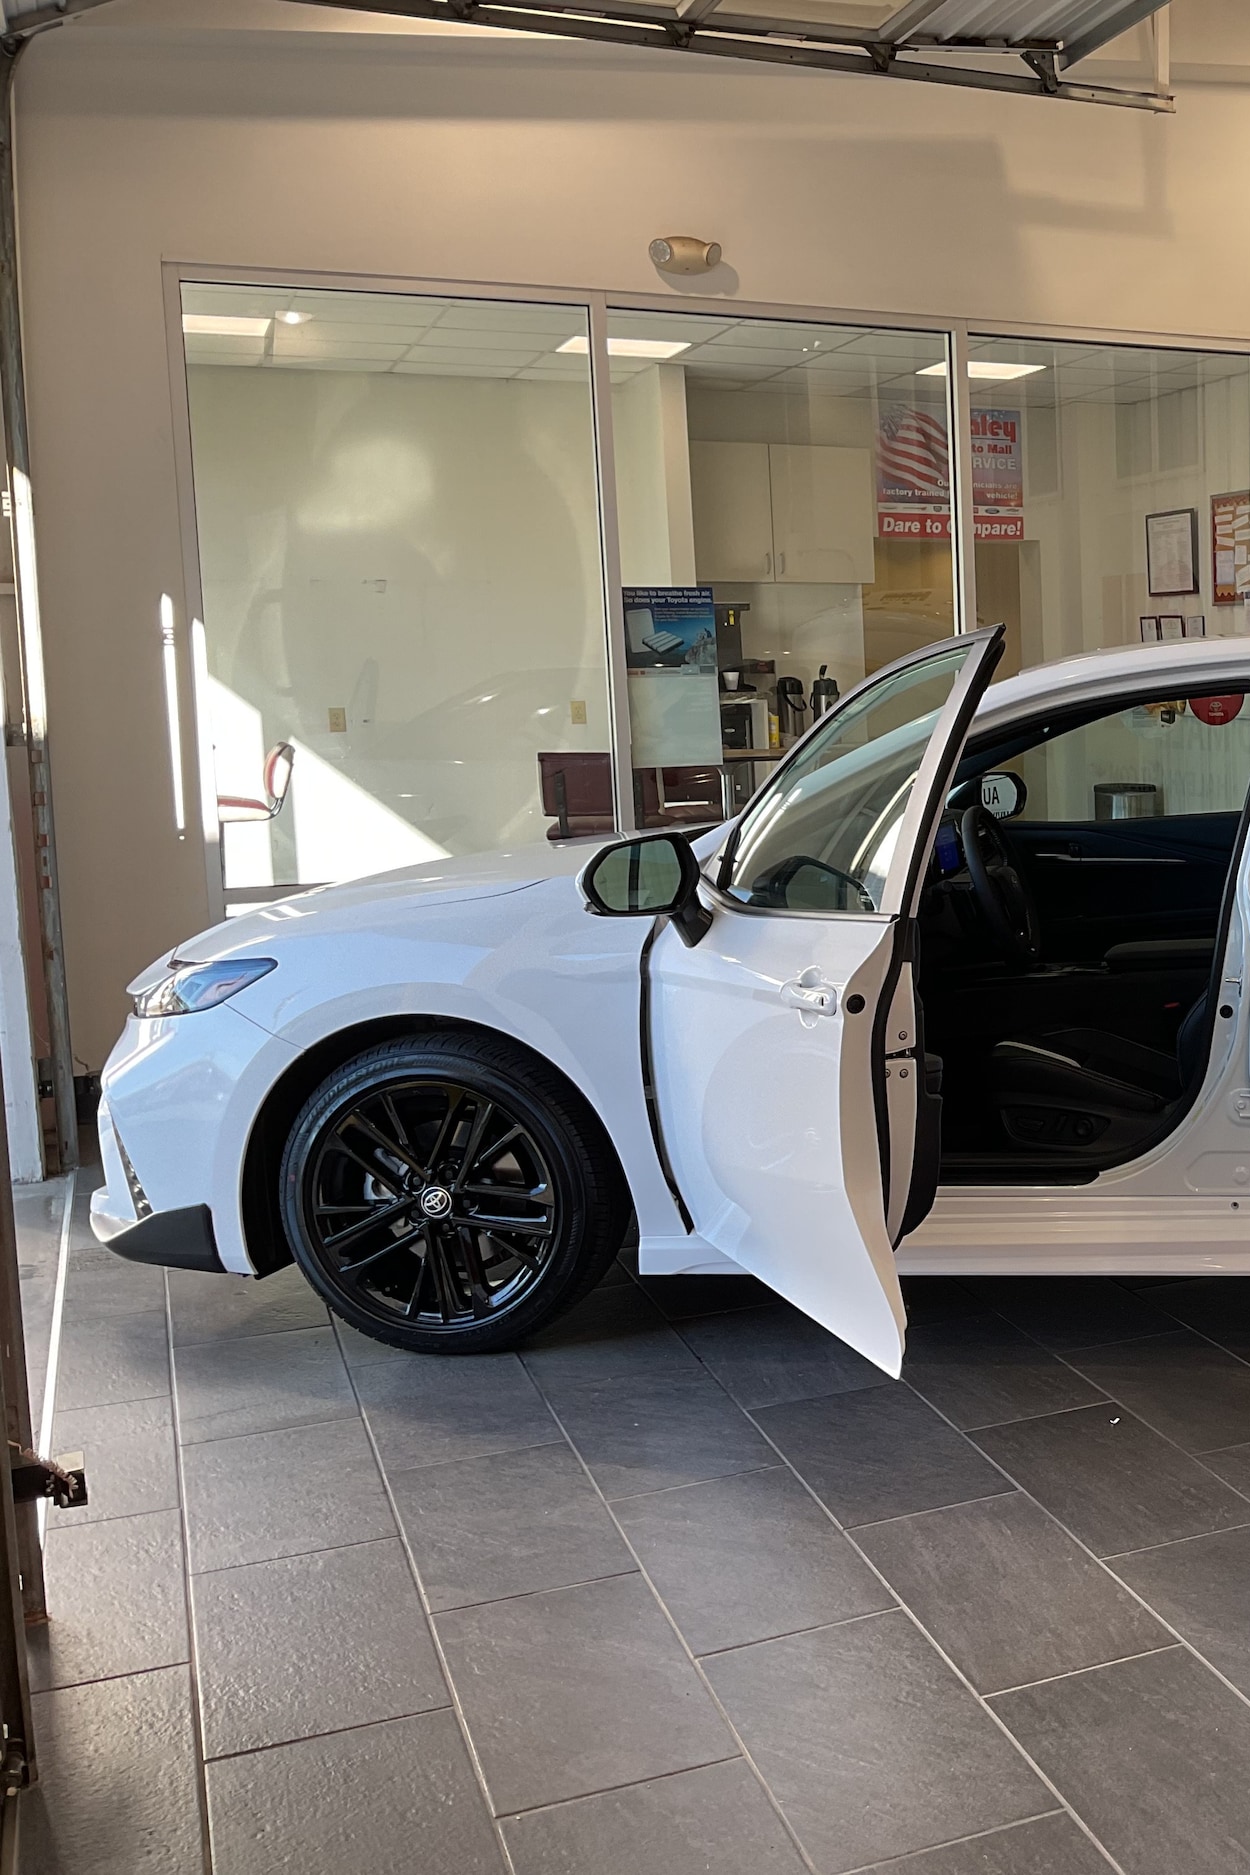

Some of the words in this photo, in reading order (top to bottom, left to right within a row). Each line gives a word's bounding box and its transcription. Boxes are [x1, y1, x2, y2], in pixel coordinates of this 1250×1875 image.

[987, 444, 1012, 454] Mall
[973, 457, 1017, 470] RVICE
[882, 488, 913, 497] factory
[915, 489, 945, 497] trained
[882, 517, 921, 533] Dare
[925, 519, 942, 533] to
